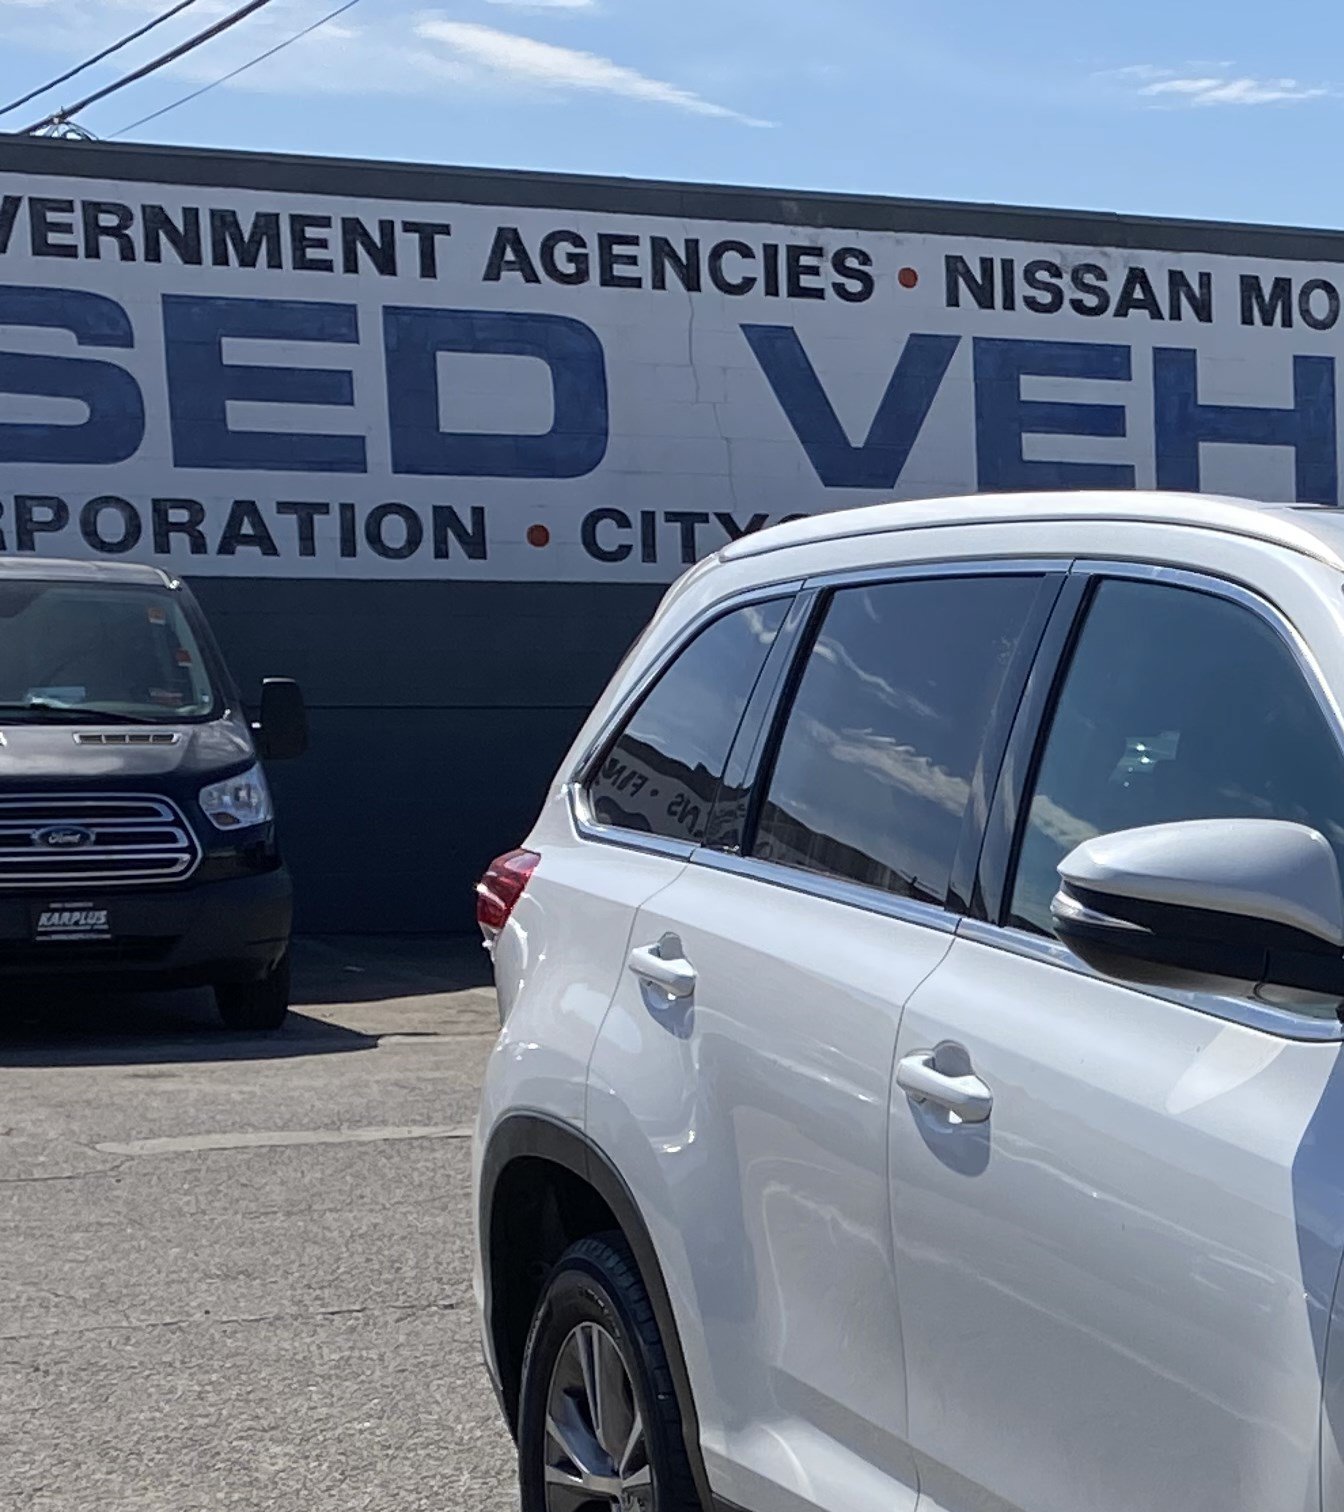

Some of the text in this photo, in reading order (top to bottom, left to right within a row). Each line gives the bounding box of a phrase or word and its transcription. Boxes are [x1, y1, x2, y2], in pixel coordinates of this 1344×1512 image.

[482, 226, 875, 302] AGENCIES
[944, 253, 1213, 324] NISSAN
[0, 284, 610, 479] SED
[0, 493, 488, 562] PORATION
[38, 909, 108, 926] KARPLUS
